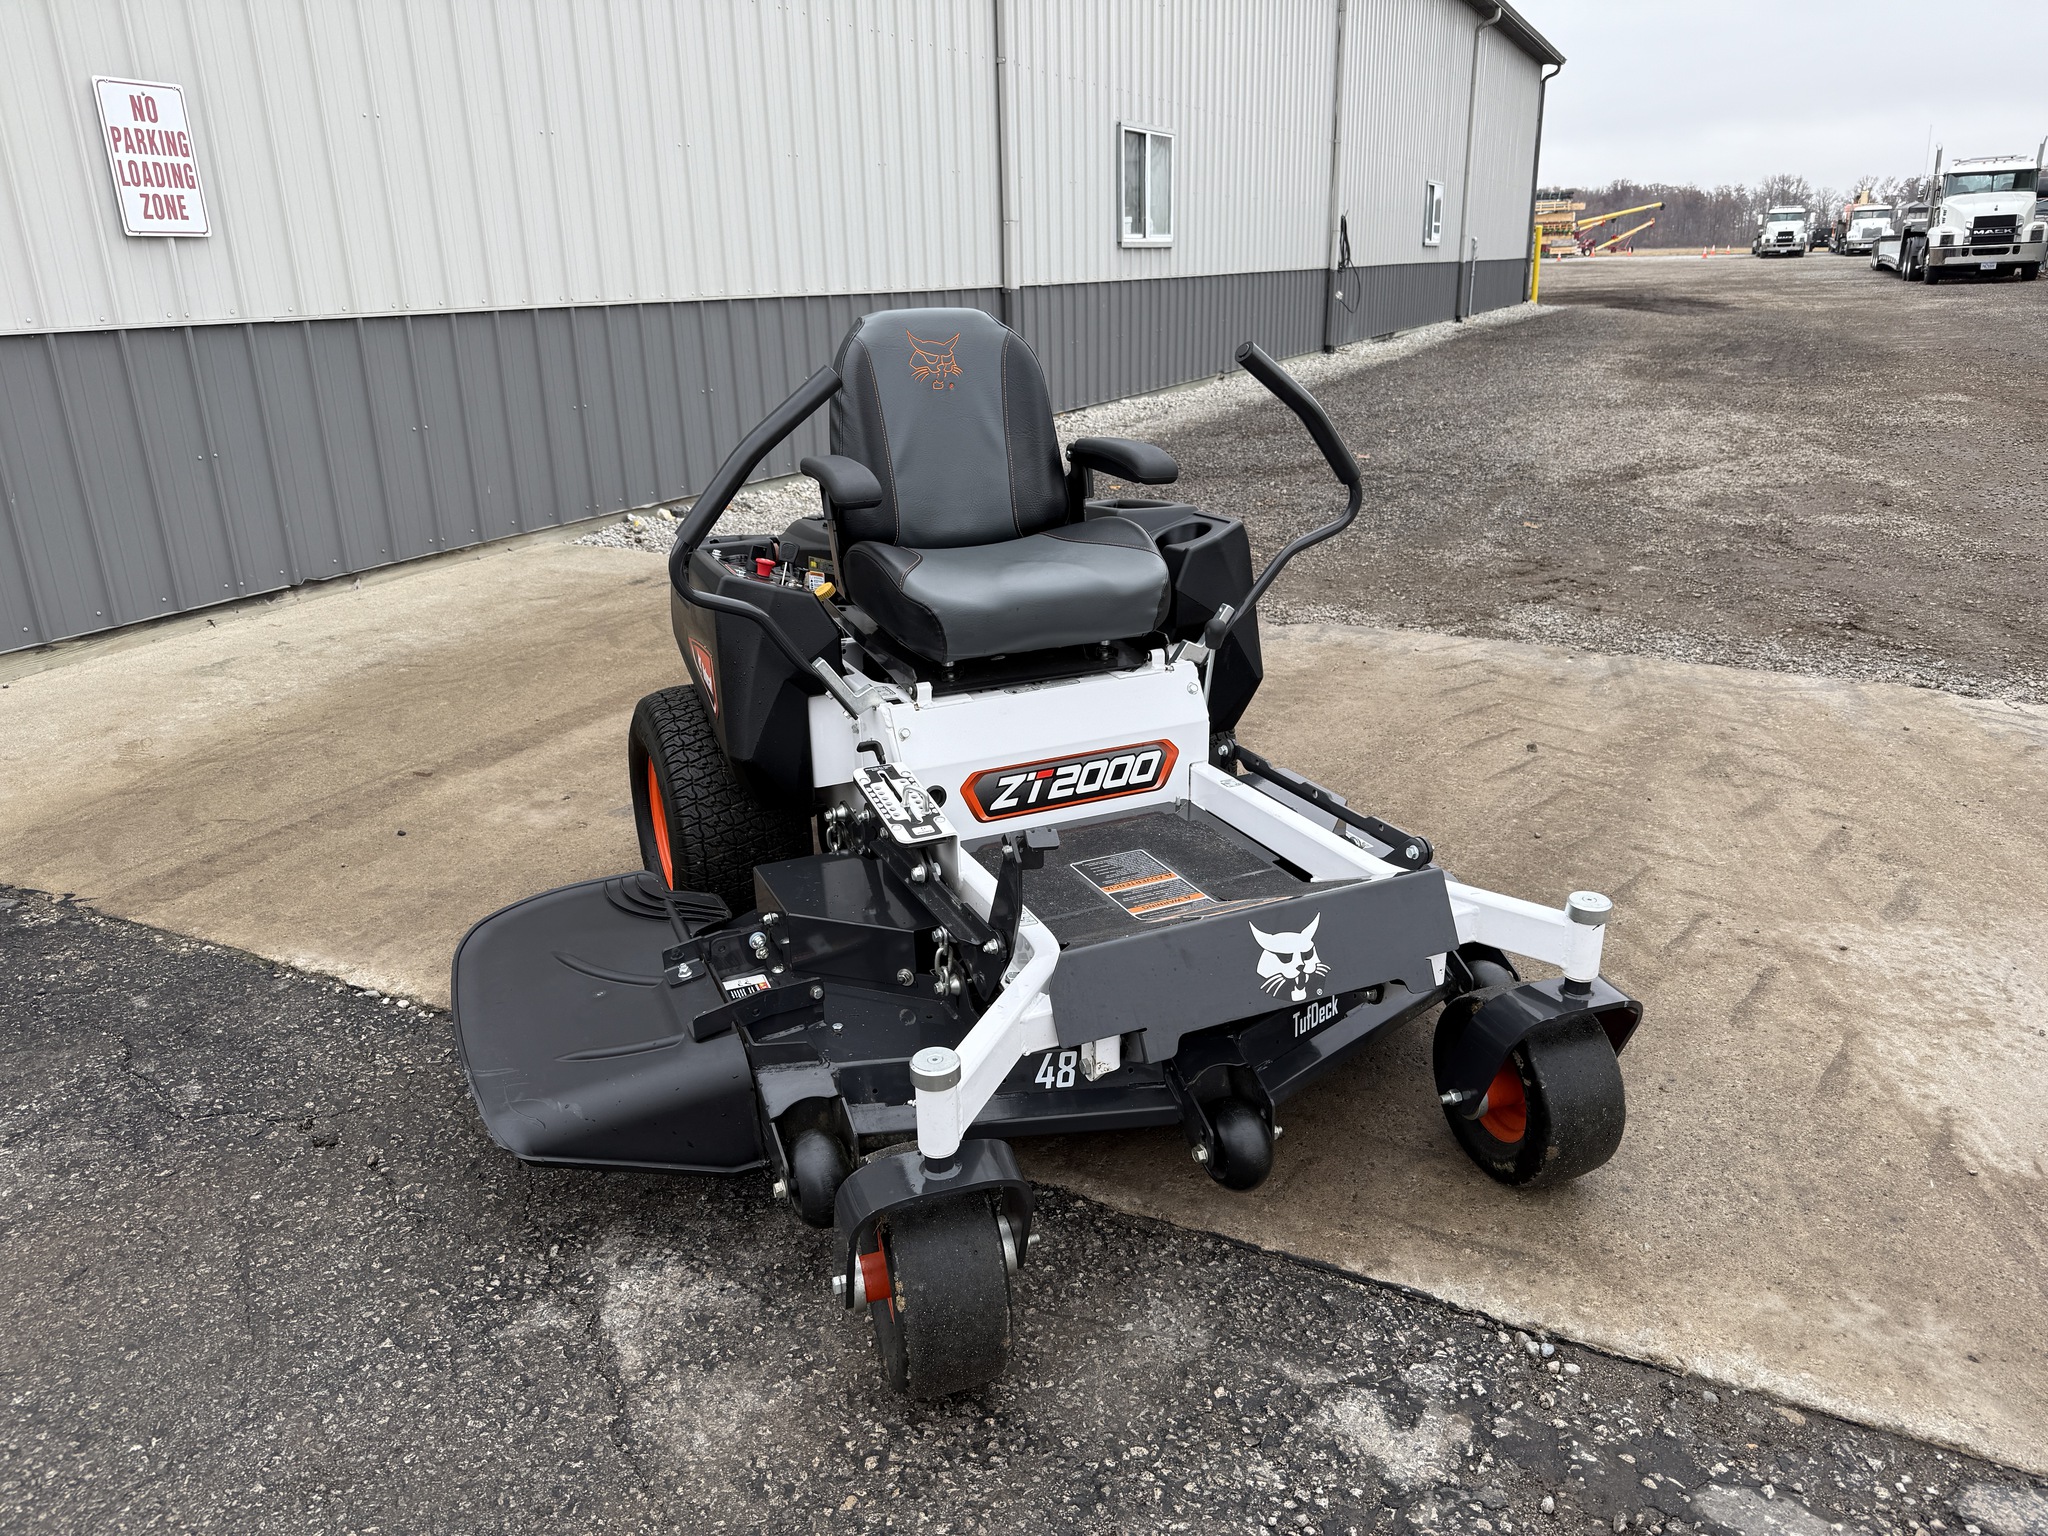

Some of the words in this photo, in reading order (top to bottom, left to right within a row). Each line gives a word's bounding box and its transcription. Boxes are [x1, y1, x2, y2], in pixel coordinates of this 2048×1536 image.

[129, 94, 159, 124] NO
[110, 126, 190, 158] PARKING
[117, 159, 196, 189] LOADING
[139, 193, 189, 221] ZONE
[989, 750, 1162, 811] ZT2000
[1141, 898, 1183, 910] WARNING
[1292, 994, 1339, 1038] TufDeck
[1034, 1050, 1078, 1090] 48
